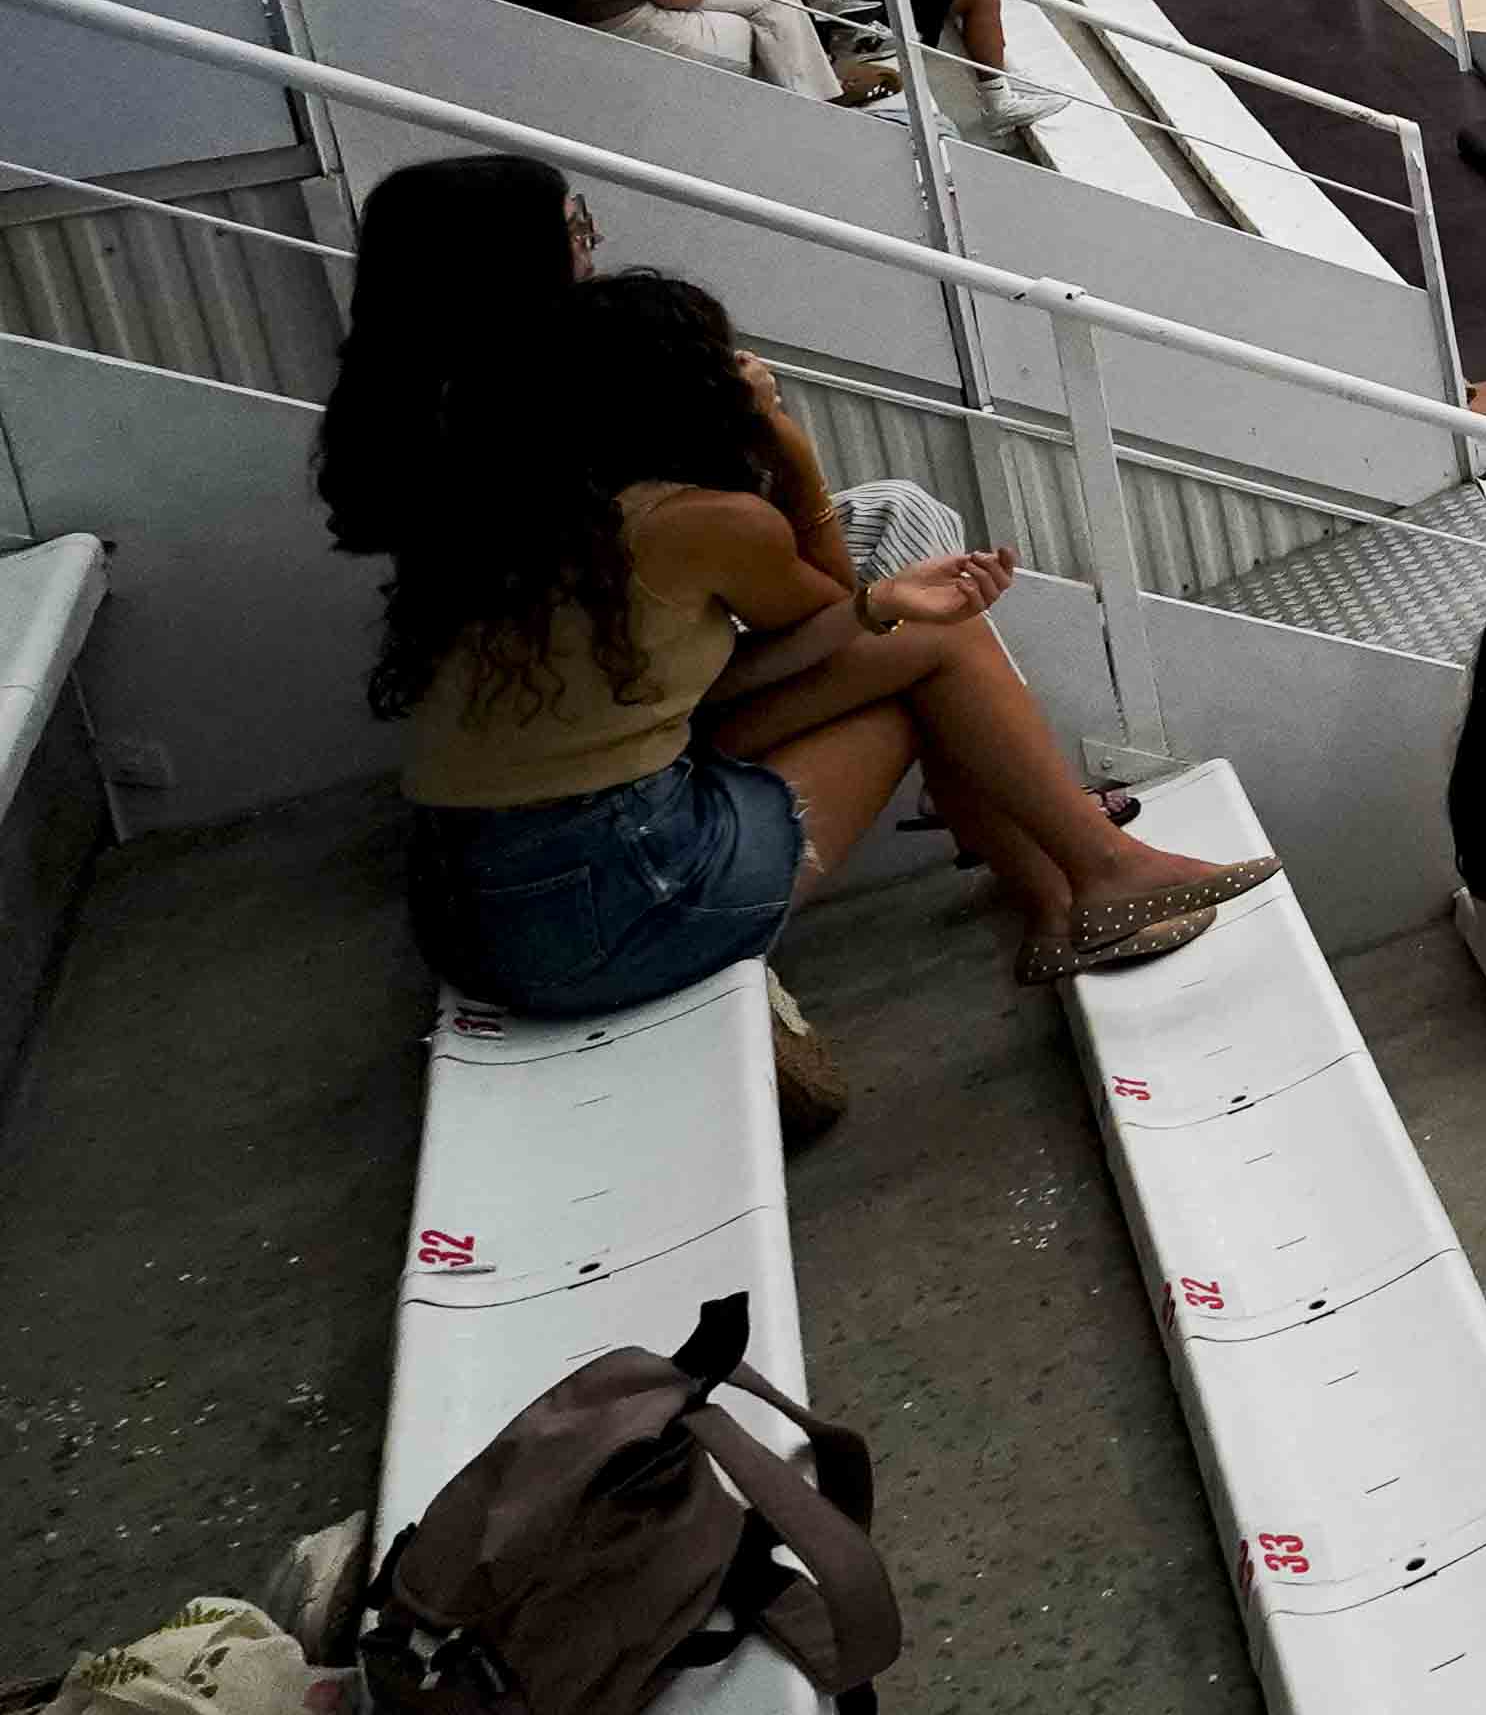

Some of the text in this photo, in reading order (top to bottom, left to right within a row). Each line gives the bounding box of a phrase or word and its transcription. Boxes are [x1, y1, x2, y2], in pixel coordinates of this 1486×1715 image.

[1112, 1075, 1152, 1102] 31
[416, 1229, 475, 1268] 32
[1180, 1276, 1226, 1311] 32
[1258, 1532, 1311, 1575] 33
